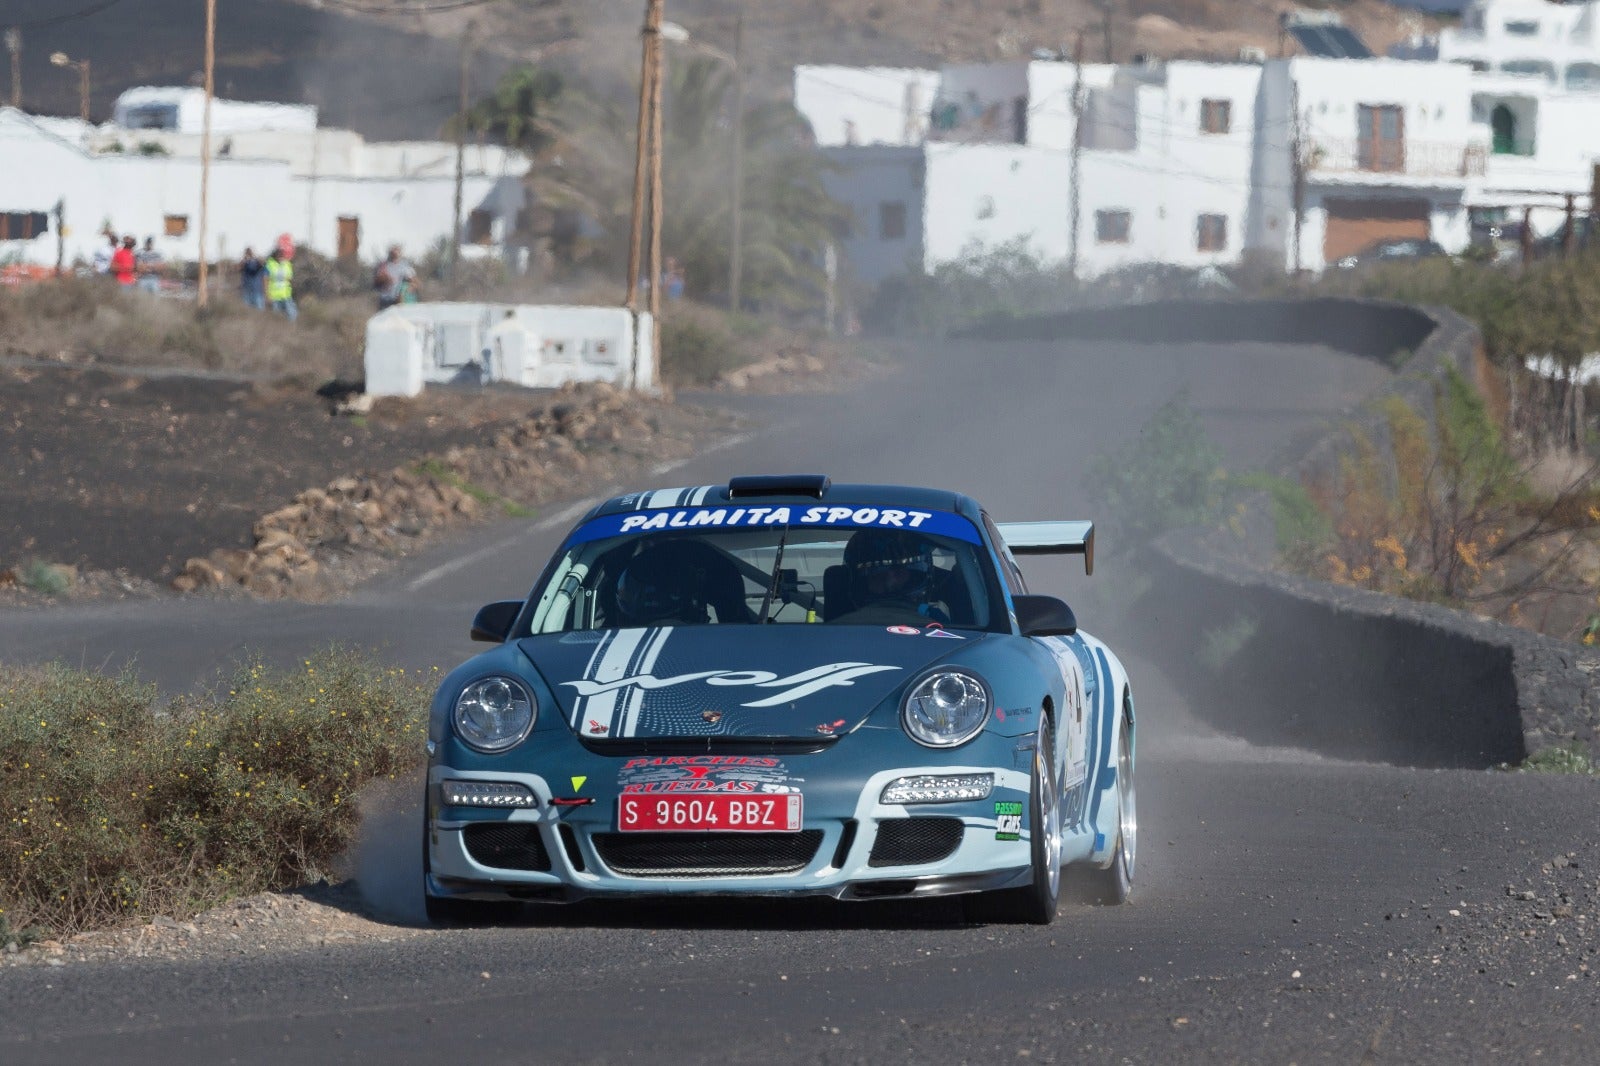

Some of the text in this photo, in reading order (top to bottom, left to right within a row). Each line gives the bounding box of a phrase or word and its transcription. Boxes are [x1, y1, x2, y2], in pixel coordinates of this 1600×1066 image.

[620, 507, 932, 532] PALMITA SPORT
[624, 756, 779, 769] PARCHES
[679, 765, 735, 780] Y
[623, 780, 759, 793] RUEDAS
[625, 800, 775, 825] S 9604 BBZ
